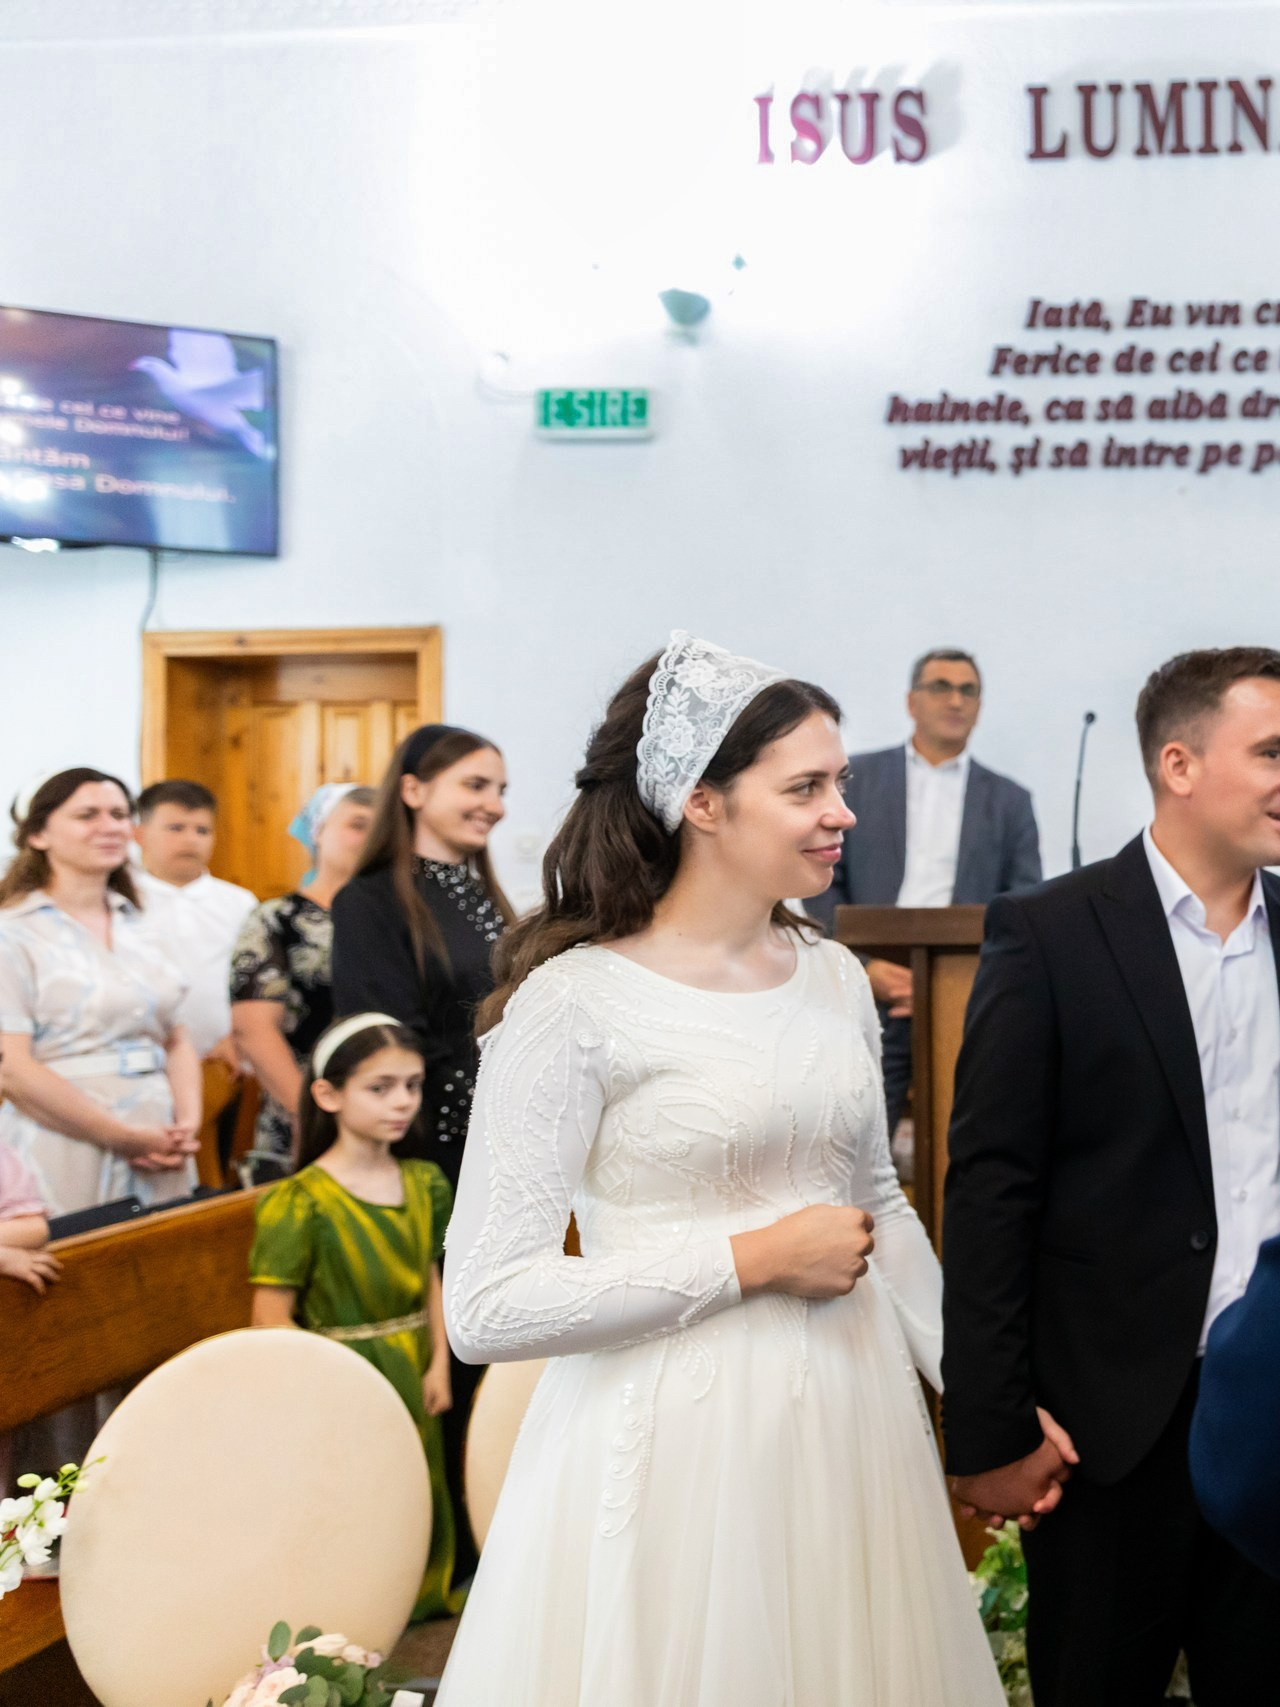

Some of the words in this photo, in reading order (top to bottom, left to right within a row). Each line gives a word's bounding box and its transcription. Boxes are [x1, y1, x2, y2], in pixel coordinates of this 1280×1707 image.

[753, 90, 927, 165] ISUS
[1026, 298, 1113, 333] Iată,
[1125, 298, 1175, 328] Eu
[1187, 301, 1242, 327] vin
[989, 343, 1102, 377] Ferice
[1114, 343, 1157, 375] de
[1232, 347, 1270, 374] ce
[886, 390, 1032, 427] hainele,
[1045, 398, 1086, 422] ca
[1097, 393, 1135, 421] să
[1148, 388, 1229, 421] aibă
[1050, 441, 1090, 469] să
[1102, 436, 1190, 469] intre
[1197, 440, 1243, 475] pe
